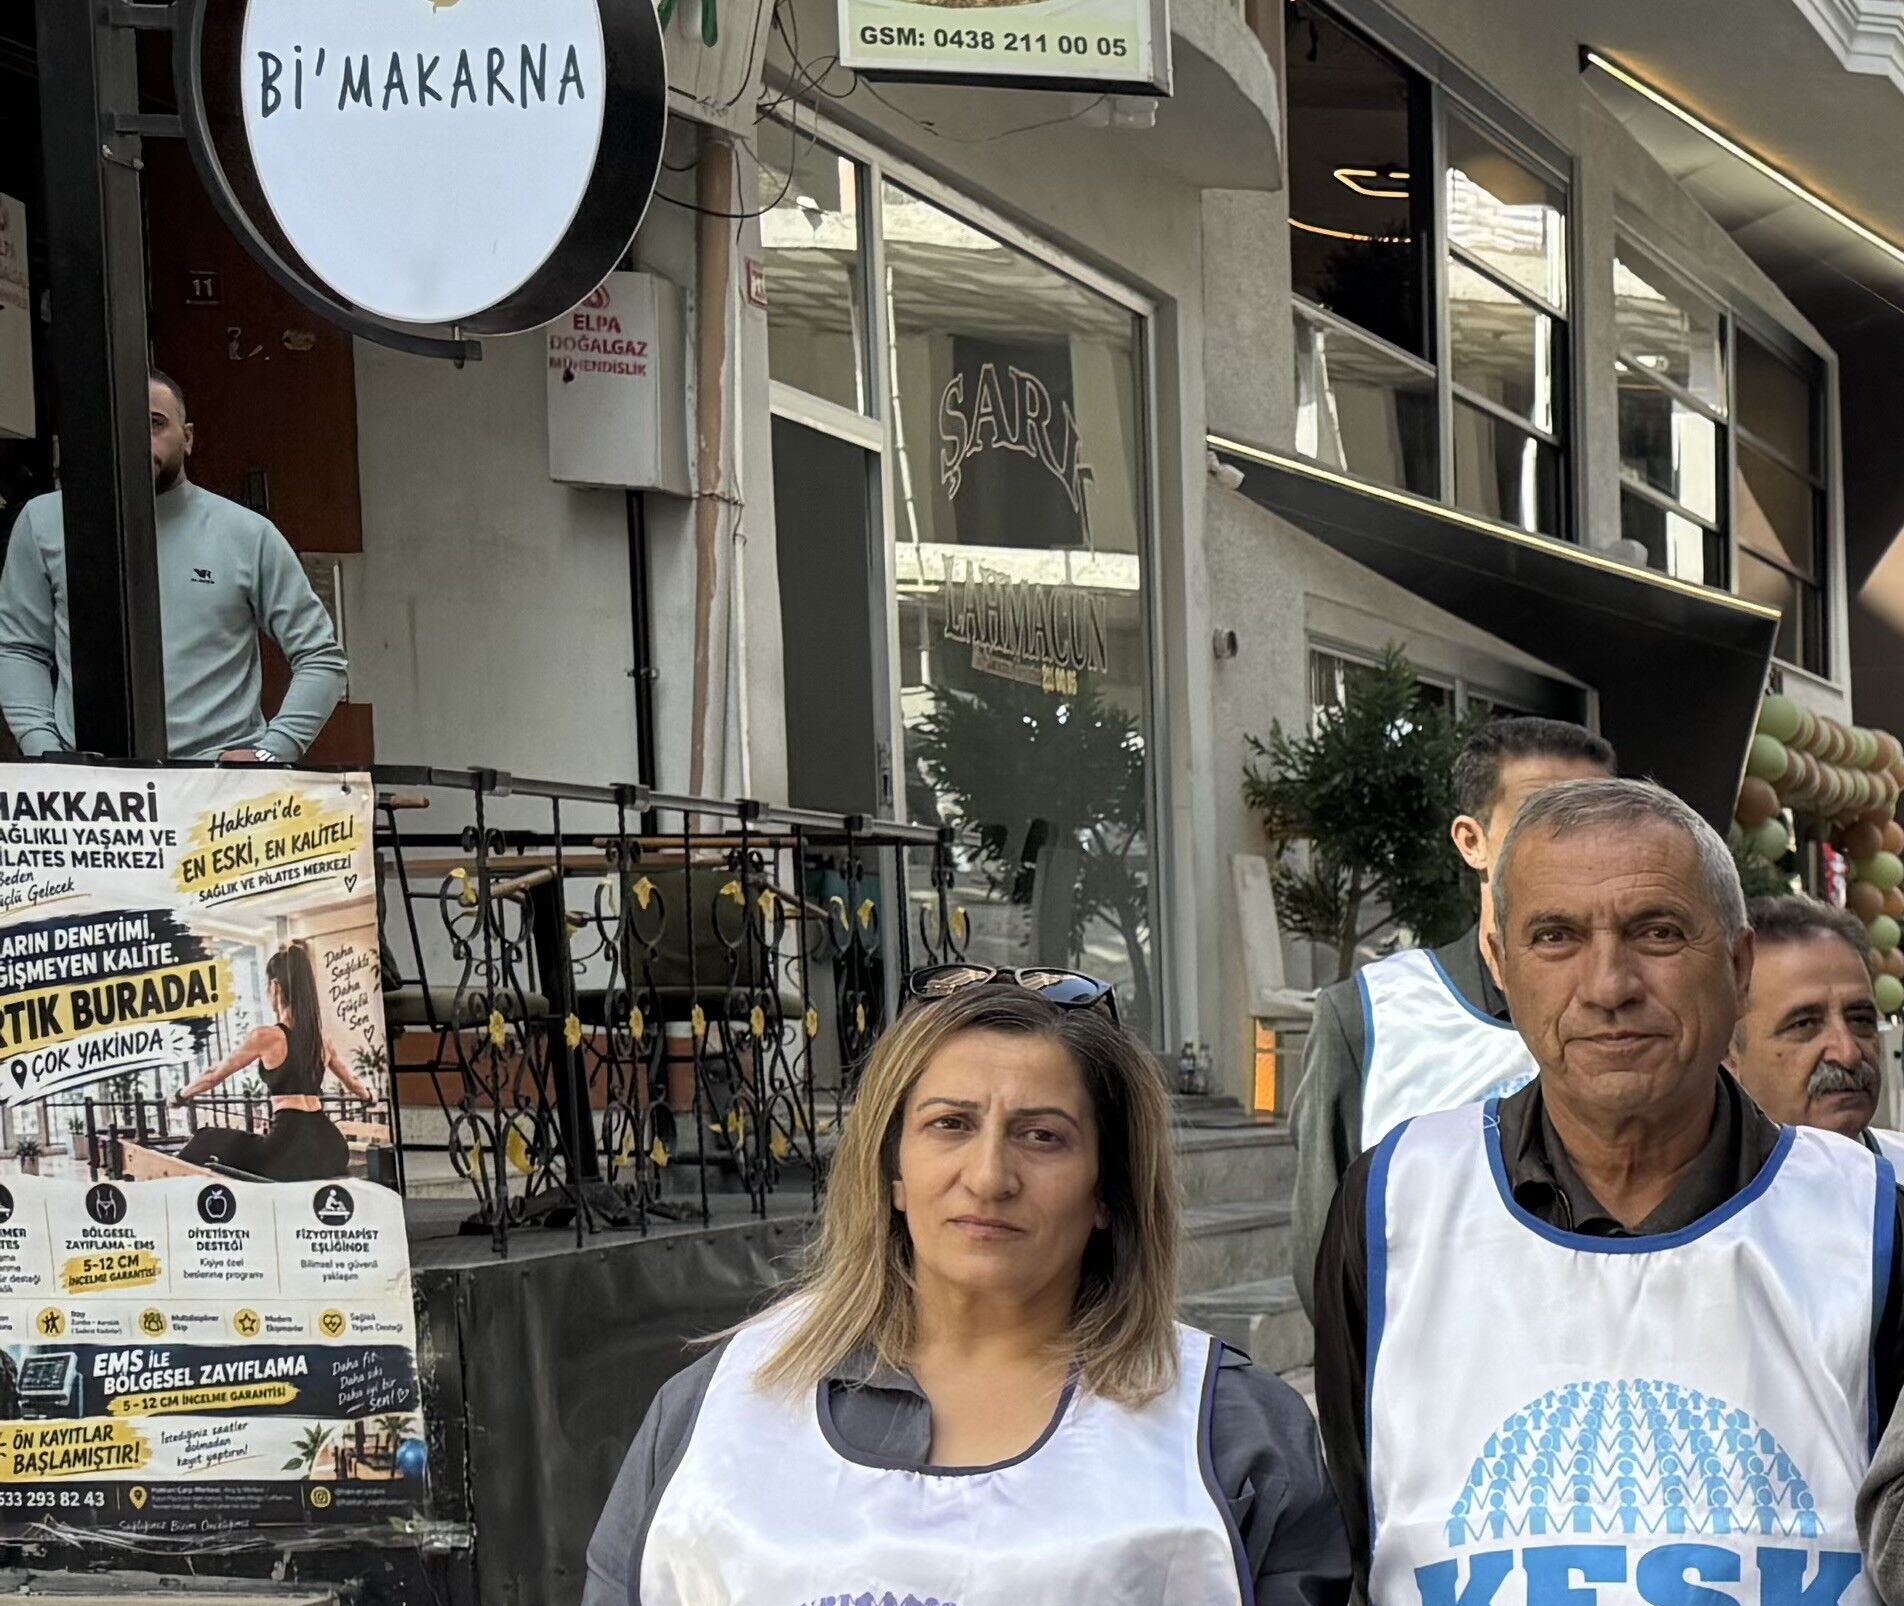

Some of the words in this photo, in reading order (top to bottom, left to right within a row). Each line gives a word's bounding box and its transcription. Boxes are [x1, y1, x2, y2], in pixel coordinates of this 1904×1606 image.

[860, 25, 926, 47] GSM:
[934, 28, 995, 50] 0438
[1003, 32, 1047, 53] 211
[1058, 35, 1088, 55] 00
[1096, 37, 1127, 57] 05
[573, 314, 621, 333] ELPA
[550, 335, 648, 358] DOĞALGAZ
[208, 795, 303, 842] Hakkari'de
[72, 829, 144, 850] YAŞAM
[149, 829, 177, 846] VE
[182, 855, 206, 883] EN
[212, 835, 260, 874] ESKİ,
[265, 837, 285, 861] EN
[291, 814, 354, 855] KALİTELİ
[71, 847, 164, 869] MERKEZİ
[28, 877, 75, 905] Gelecek
[199, 882, 239, 902] SAĞLIK
[241, 878, 255, 891] VE
[259, 868, 301, 887] PİLATES
[303, 854, 352, 877] MERKEZİ
[0, 929, 49, 959] ARIN
[55, 914, 156, 951] DENEYİMİ,
[103, 941, 179, 973] KALİTE.
[70, 965, 219, 1031] BURADA!
[32, 1048, 70, 1081] ÇOK
[82, 1226, 137, 1238] BÖLGESEL
[84, 1256, 114, 1272] 5-12
[117, 1255, 140, 1268] CM
[93, 1349, 144, 1377] EMS
[148, 1350, 170, 1368] İLE
[104, 1368, 194, 1395] BÖLGESEL
[200, 1355, 309, 1385] ZAYIFLAMA
[142, 1398, 157, 1409] 12
[160, 1396, 178, 1408] CM
[13, 1429, 34, 1450] ÖN
[40, 1424, 114, 1446] KAYITLAR
[13, 1441, 140, 1476] BAŞLAMIŞTIR!
[26, 1491, 56, 1507] 293
[60, 1491, 80, 1507] 82
[83, 1491, 105, 1507] 43
